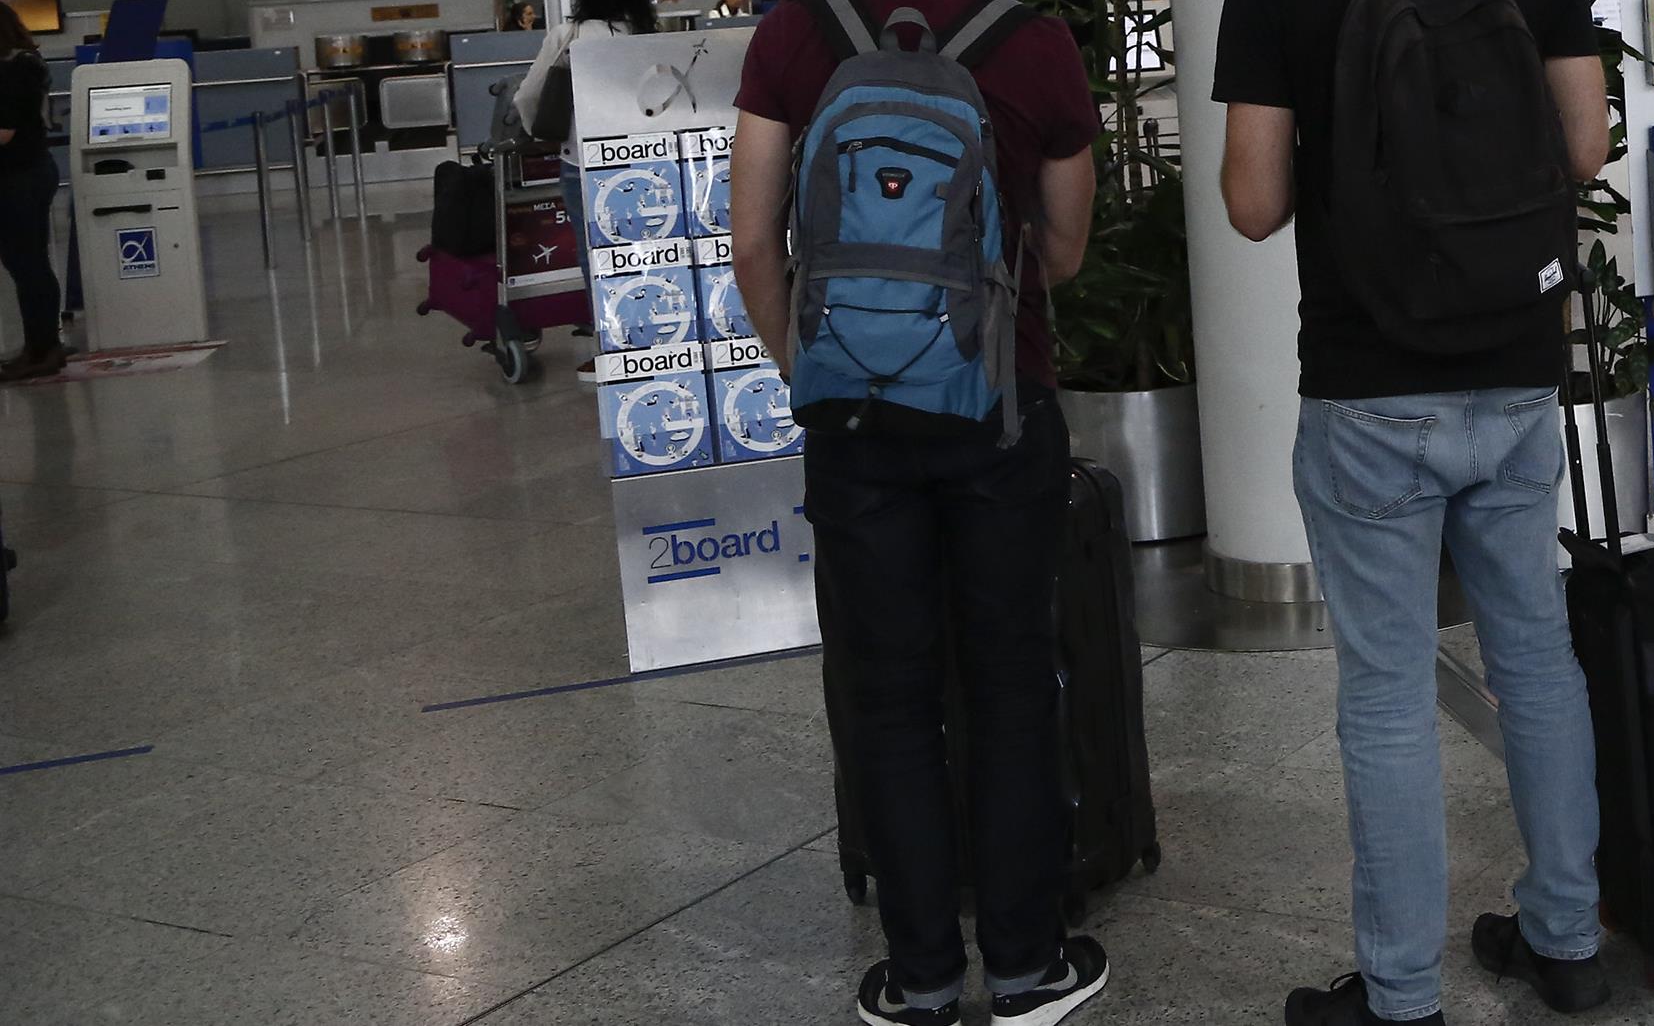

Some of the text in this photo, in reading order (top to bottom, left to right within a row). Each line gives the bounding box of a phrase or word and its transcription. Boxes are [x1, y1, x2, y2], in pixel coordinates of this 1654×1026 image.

[585, 137, 668, 167] 2board
[687, 133, 735, 157] 2boa
[597, 243, 680, 272] 2board
[608, 348, 693, 377] 2board
[716, 341, 769, 365] 2boa
[649, 520, 781, 570] 2board
